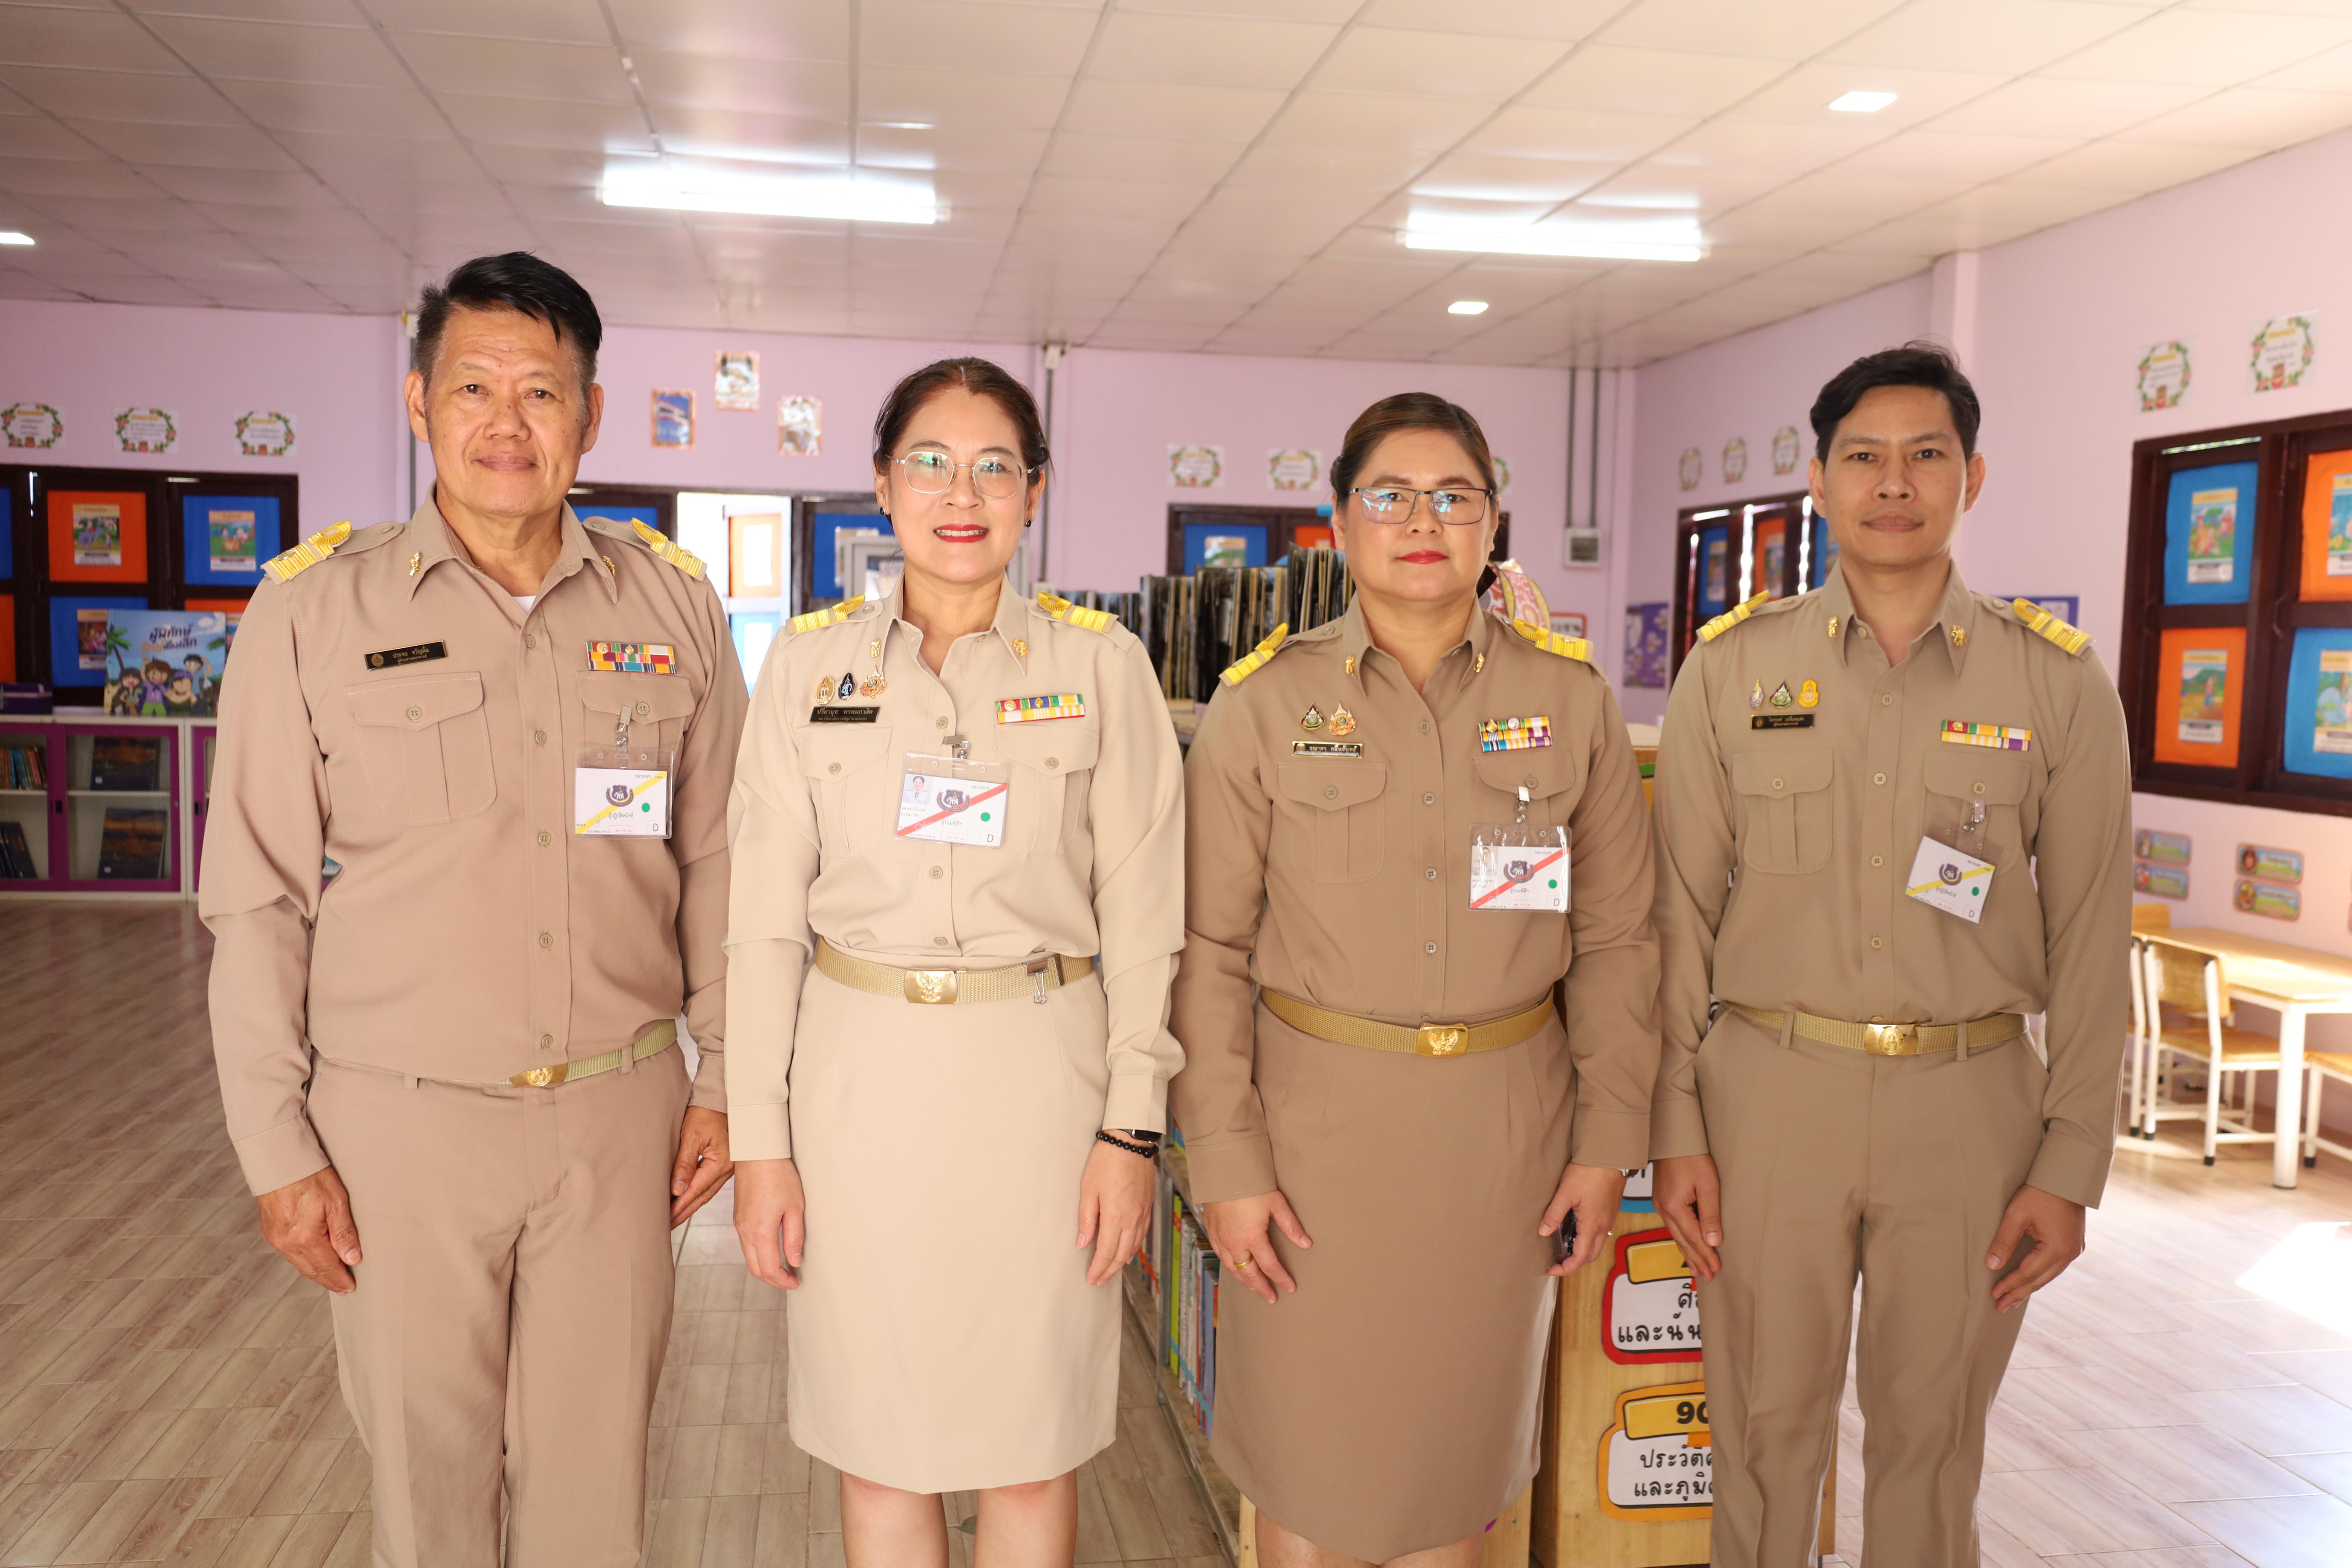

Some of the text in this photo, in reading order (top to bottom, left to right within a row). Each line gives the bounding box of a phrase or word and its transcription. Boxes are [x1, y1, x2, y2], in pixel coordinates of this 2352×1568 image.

[817, 708, 839, 717] ปรียานุช
[653, 823, 659, 831] D
[1553, 898, 1560, 906] D
[1969, 910, 1975, 918] D
[1678, 1282, 1699, 1309] ศิ
